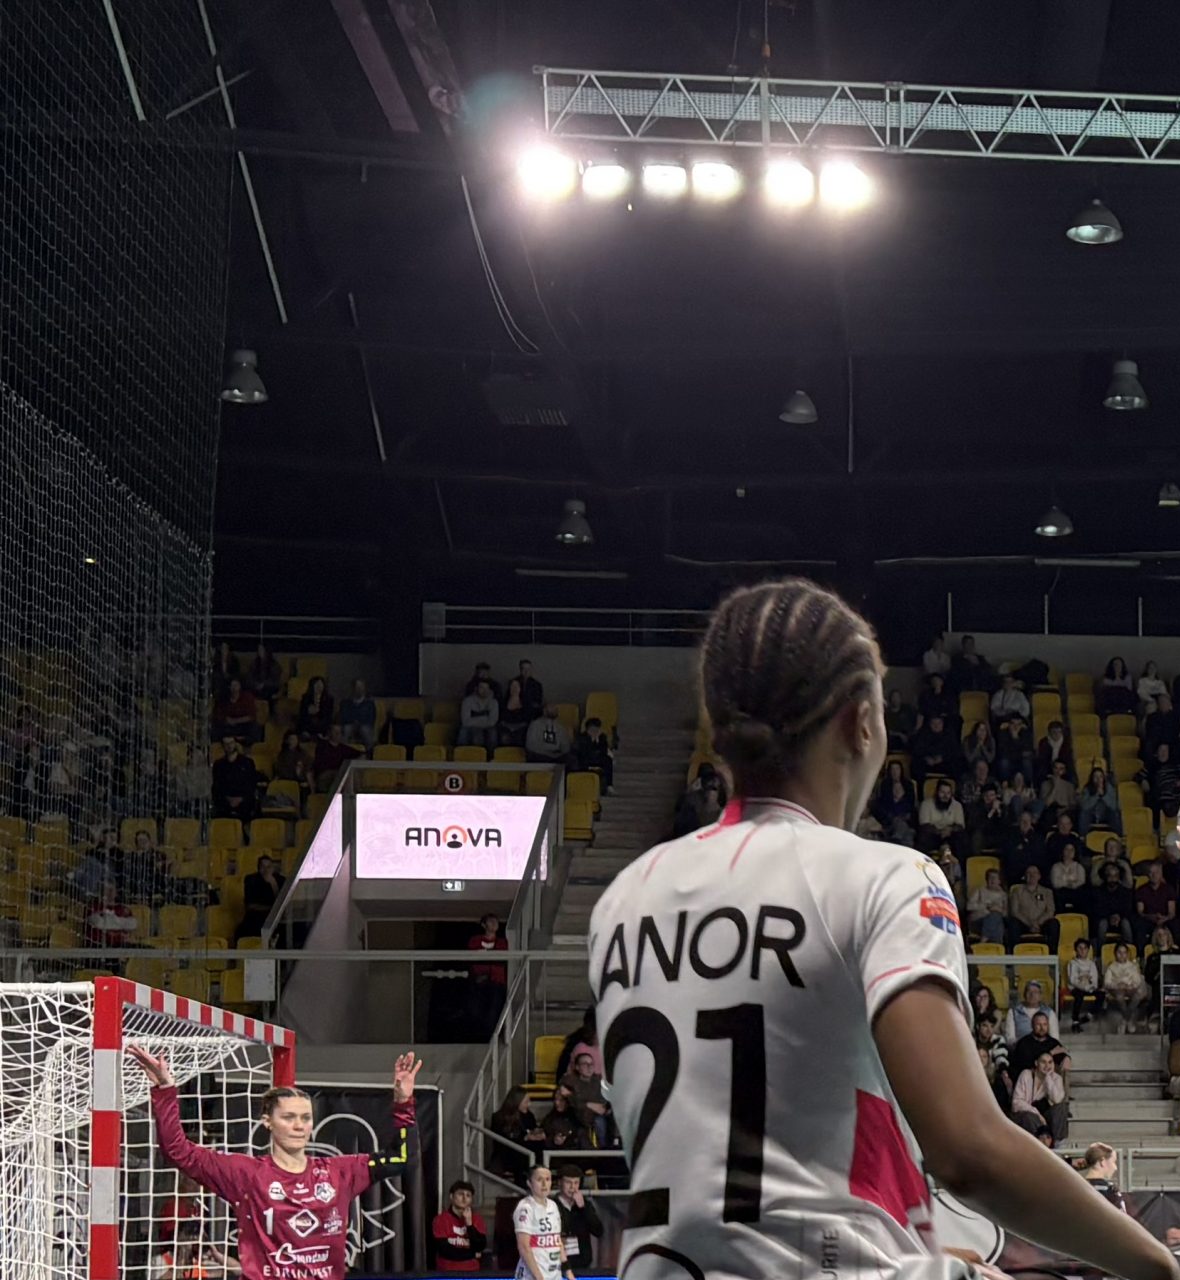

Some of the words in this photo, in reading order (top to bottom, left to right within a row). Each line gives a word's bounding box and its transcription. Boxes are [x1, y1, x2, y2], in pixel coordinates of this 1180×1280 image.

[449, 777, 460, 789] B
[405, 825, 502, 848] ANOVA
[593, 904, 806, 1001] ANOR
[603, 1003, 767, 1230] 21
[263, 1207, 274, 1236] 1
[539, 1217, 552, 1233] 55
